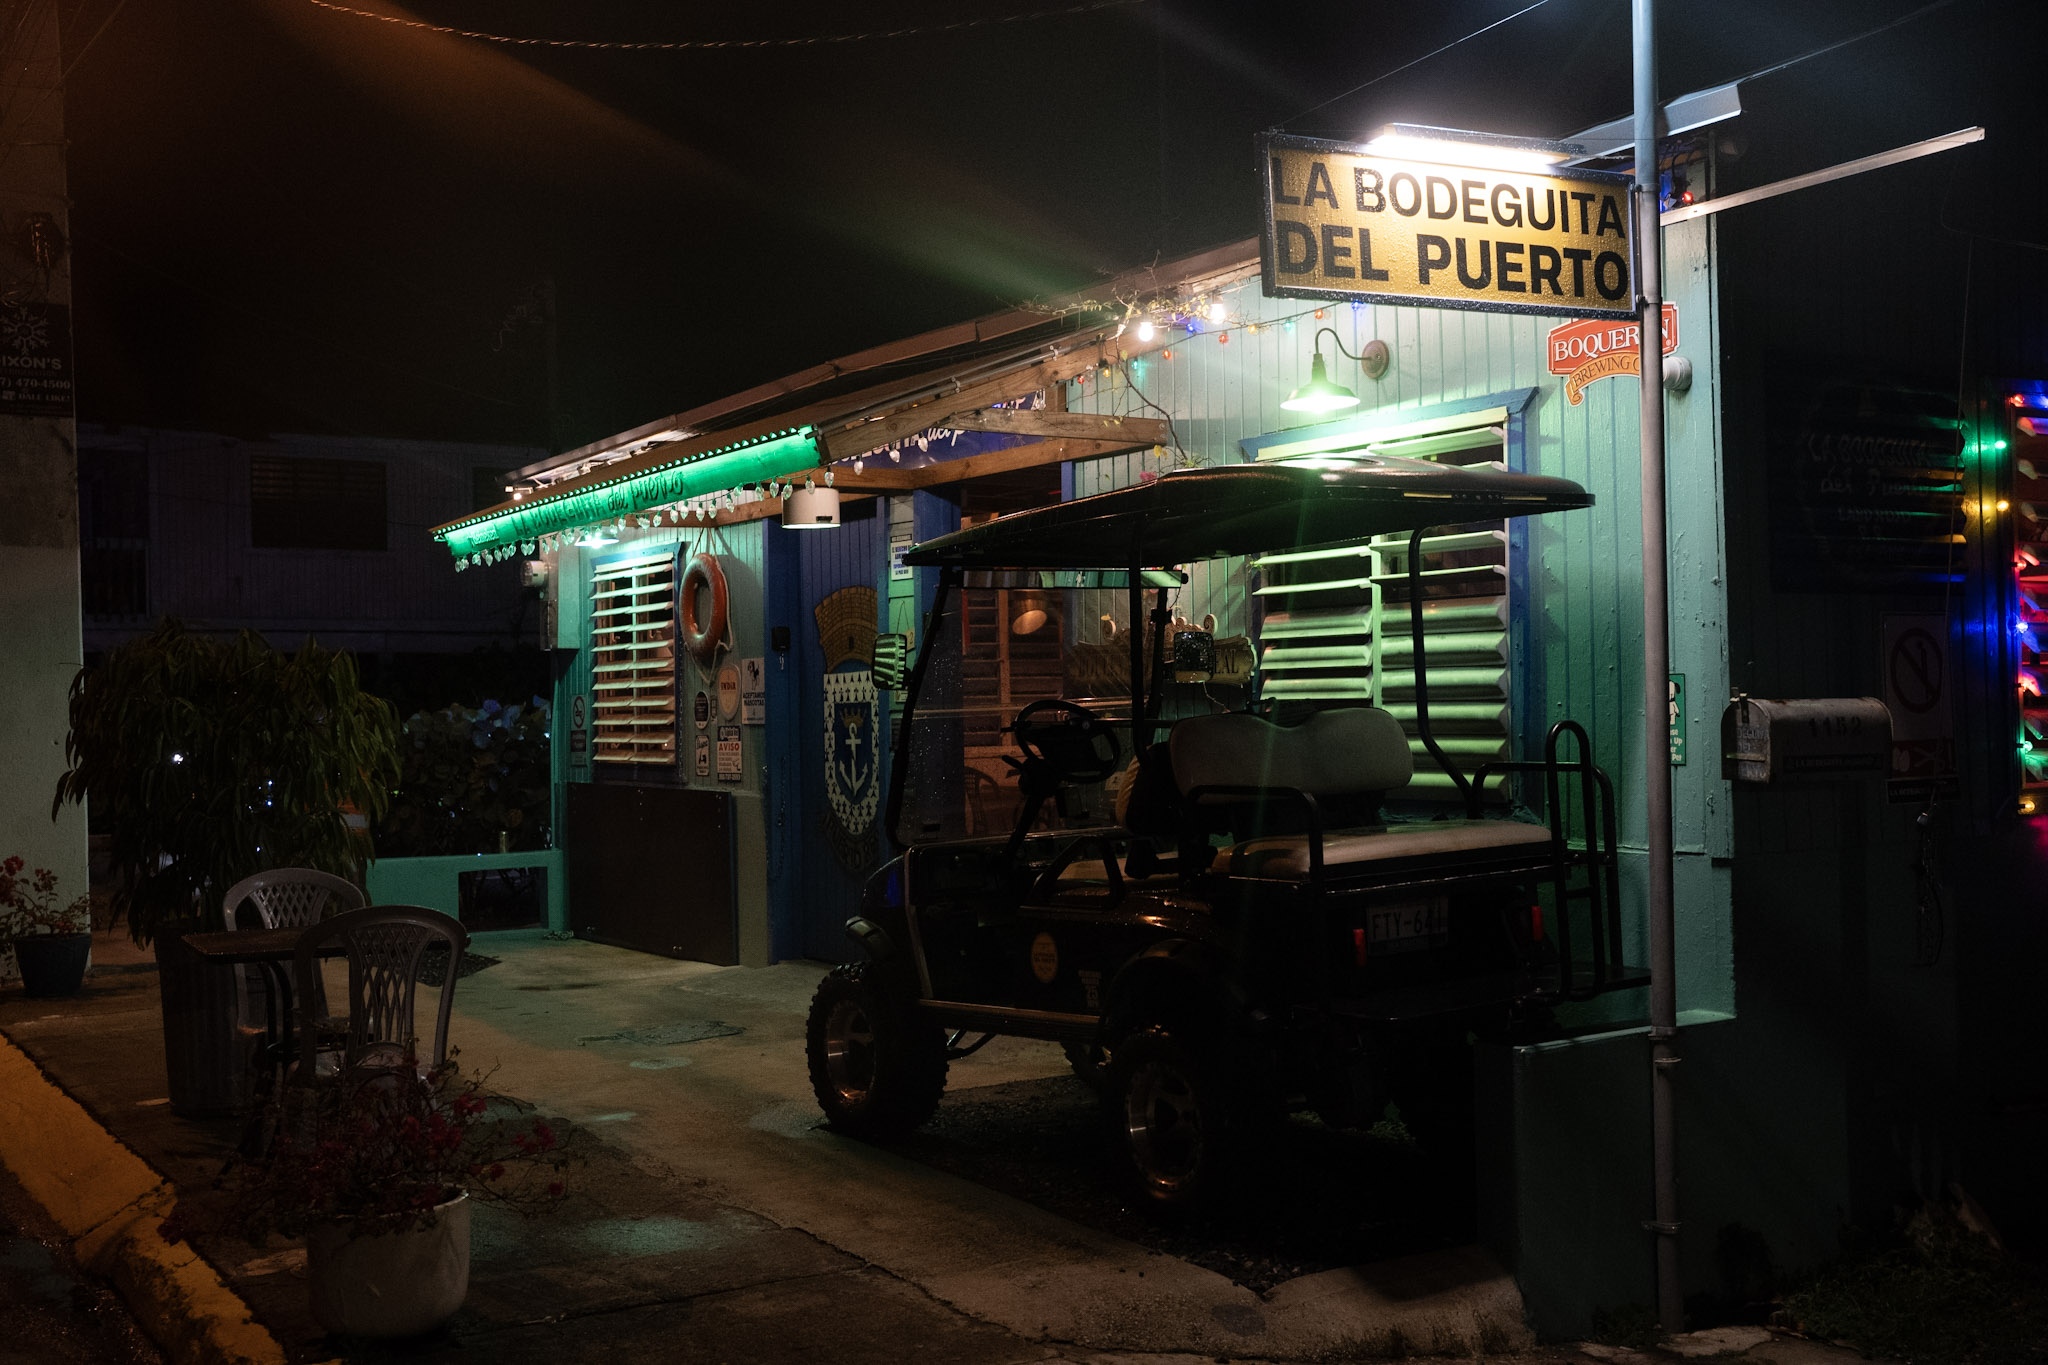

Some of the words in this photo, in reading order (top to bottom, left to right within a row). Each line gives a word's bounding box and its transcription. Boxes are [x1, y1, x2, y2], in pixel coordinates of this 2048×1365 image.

[1271, 156, 1339, 210] LA
[1353, 166, 1627, 239] BODEGUITA
[1275, 219, 1389, 282] DEL
[1416, 233, 1630, 301] PUERTO
[1554, 317, 1670, 362] BOQUERN
[0, 355, 63, 370] IXON'S
[1573, 355, 1630, 388] BREWING
[1808, 716, 1862, 738] 1152
[719, 742, 740, 751] AVISO
